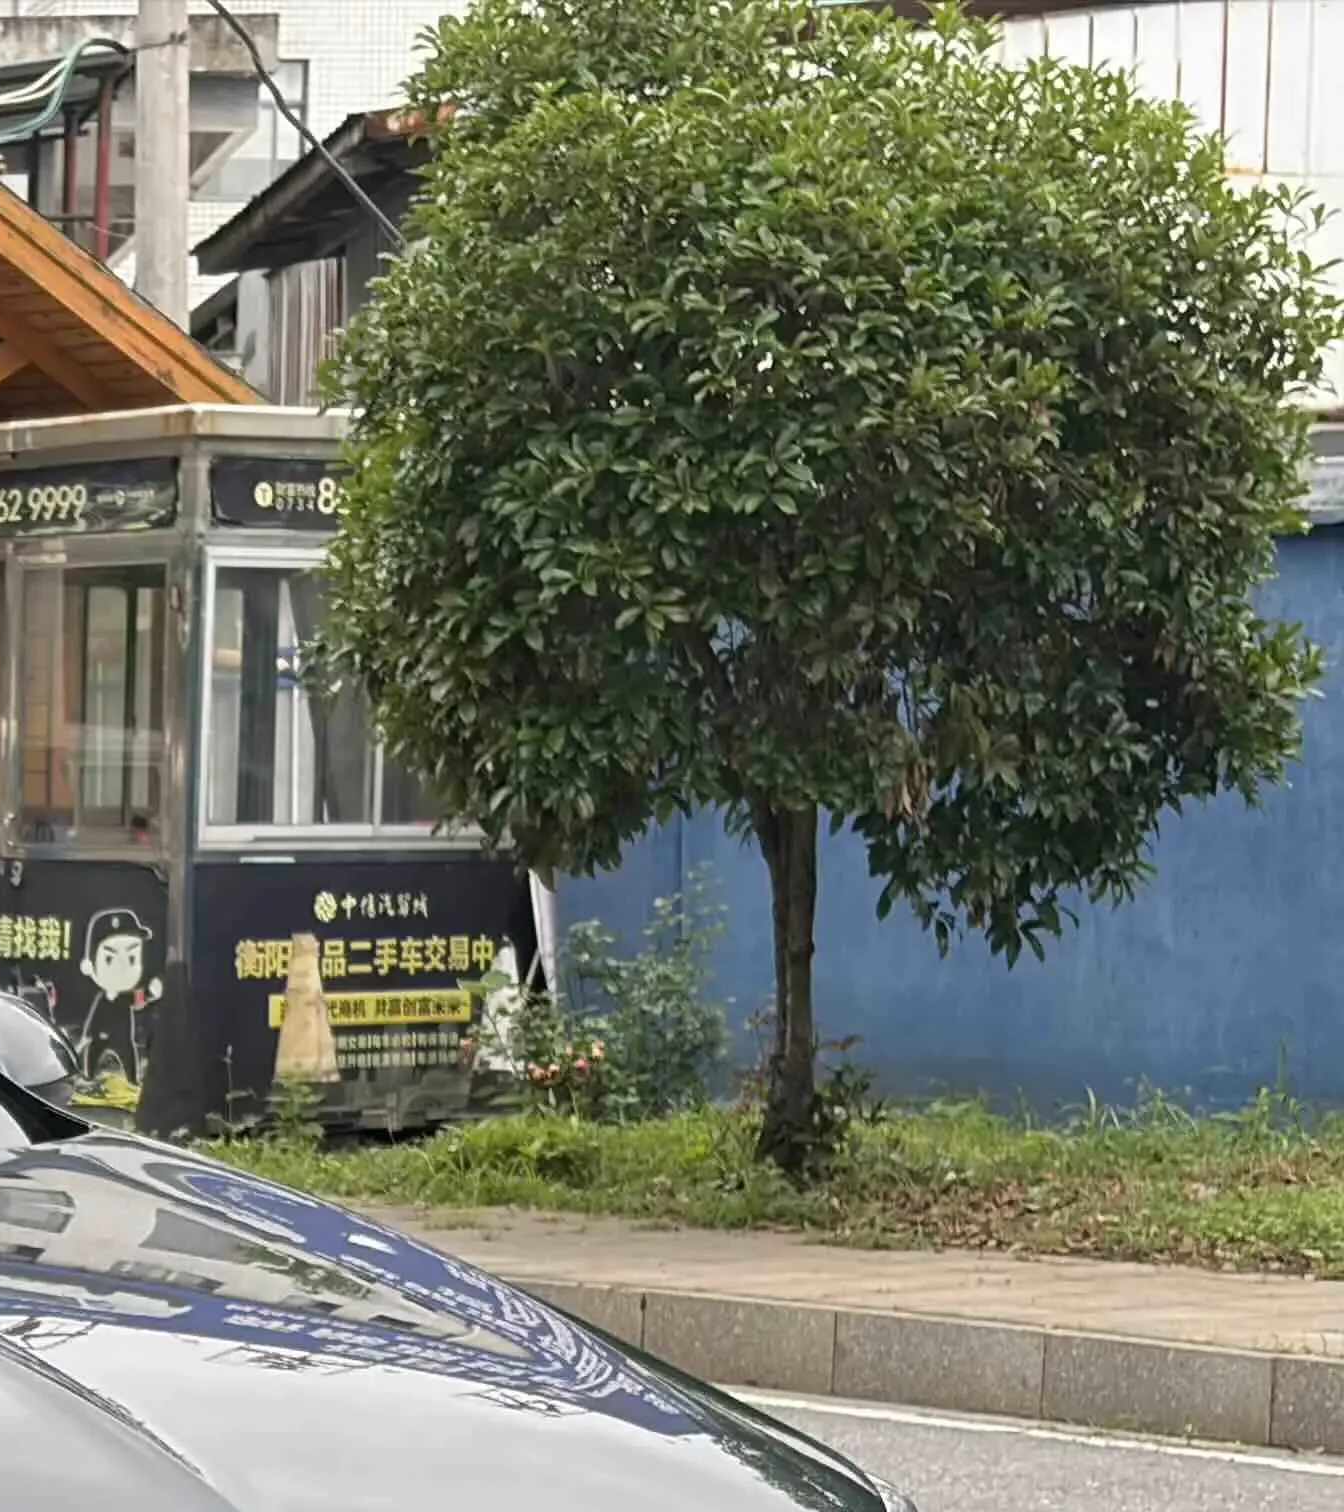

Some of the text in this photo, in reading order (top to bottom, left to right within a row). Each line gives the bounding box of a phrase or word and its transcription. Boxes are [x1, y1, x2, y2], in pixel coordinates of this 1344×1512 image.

[27, 484, 87, 520] 9999
[234, 933, 516, 980] 衡阳品二手车交易中
